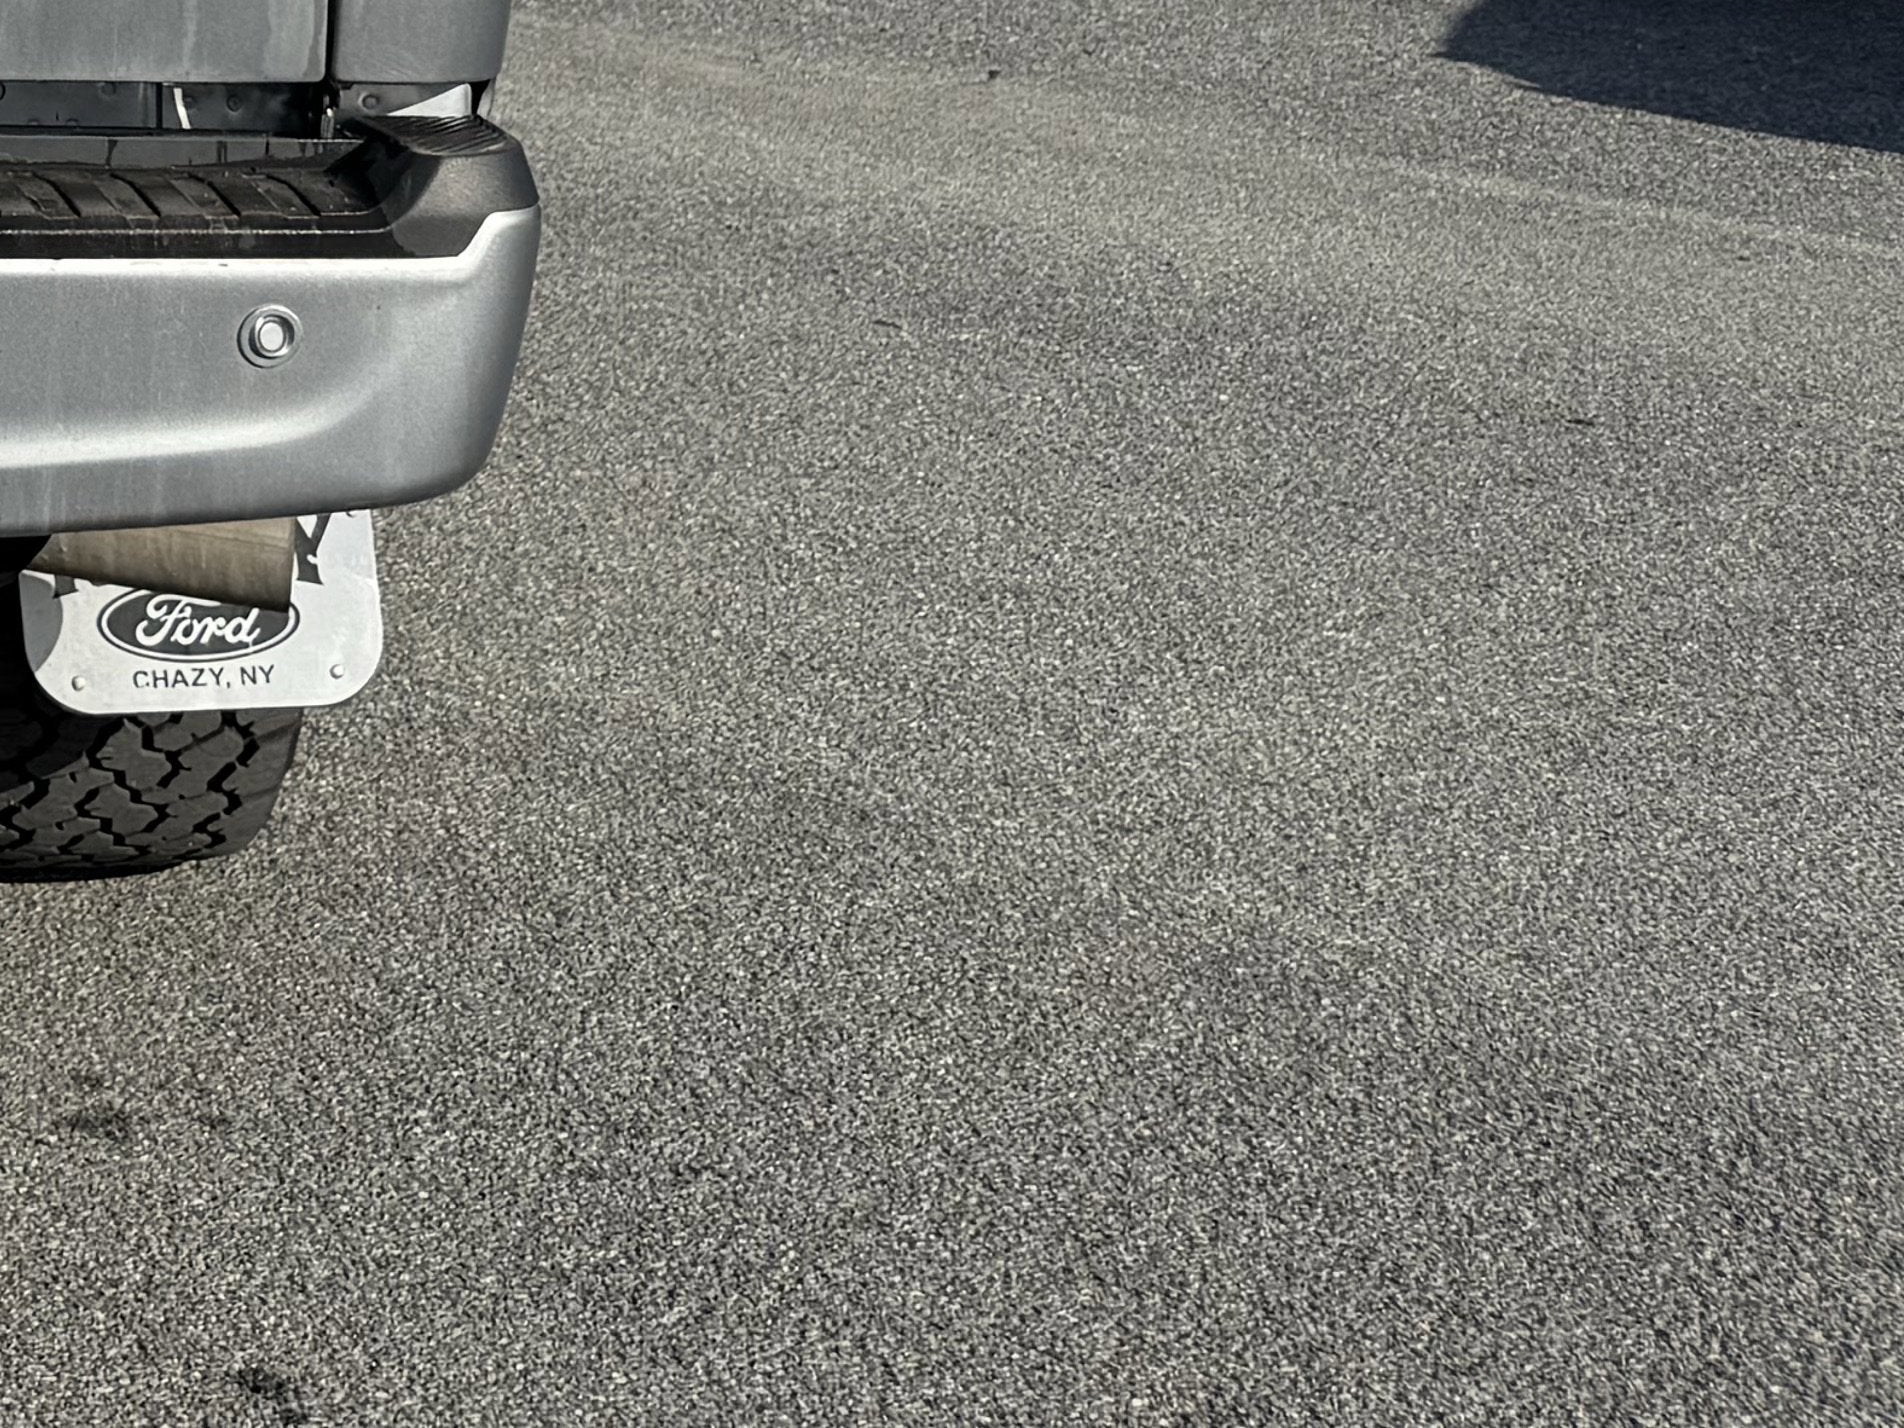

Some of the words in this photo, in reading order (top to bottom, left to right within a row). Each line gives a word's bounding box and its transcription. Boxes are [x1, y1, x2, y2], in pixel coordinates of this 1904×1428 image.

[135, 593, 261, 646] Ford
[133, 669, 231, 689] CHAZY,
[241, 664, 275, 685] NY
